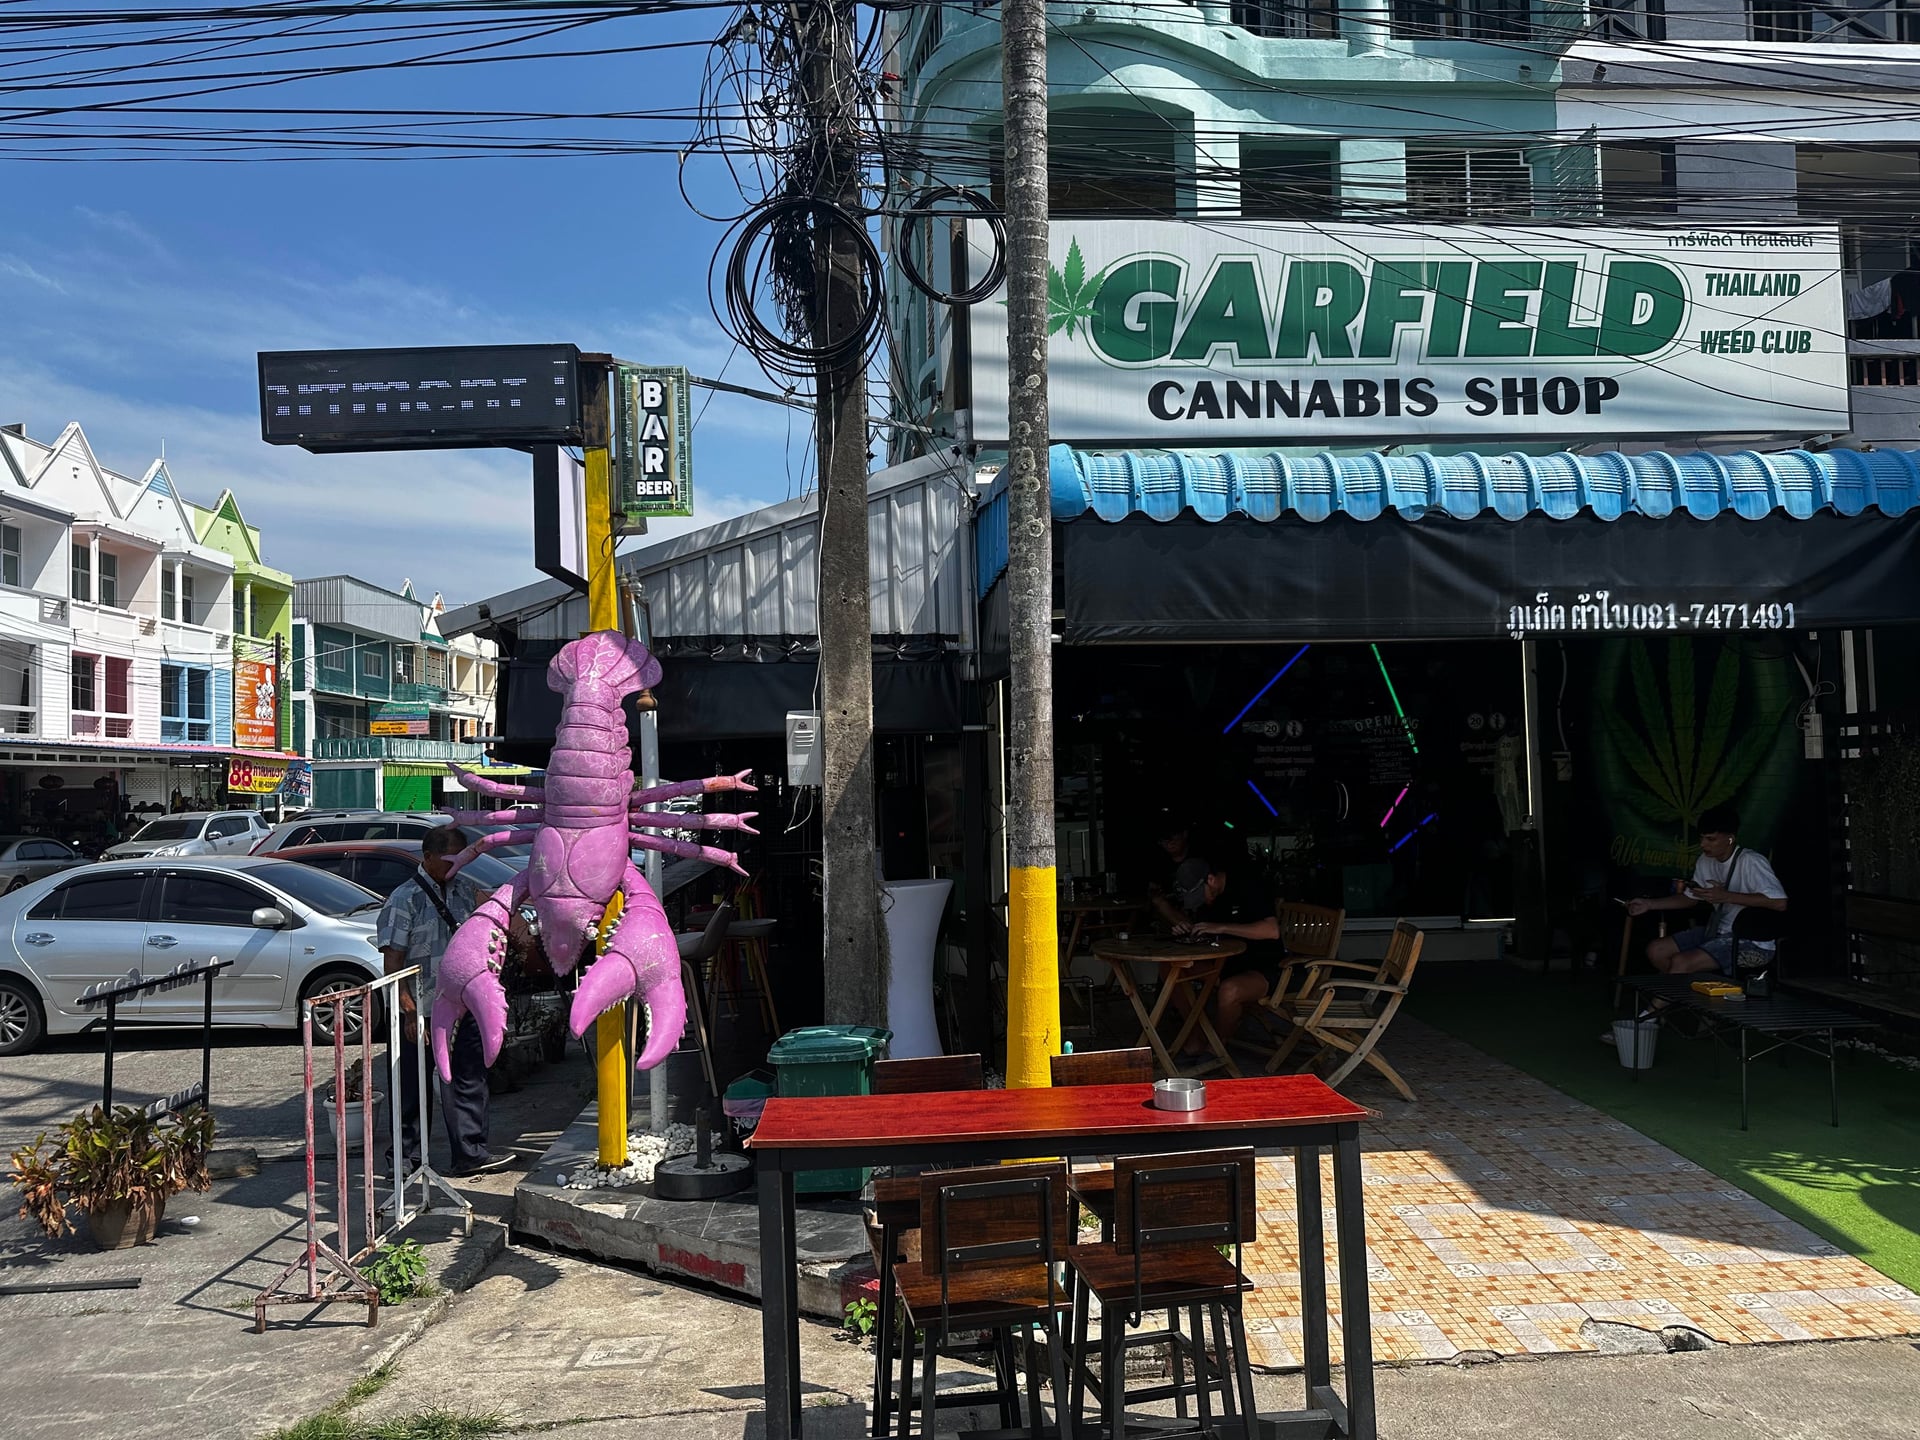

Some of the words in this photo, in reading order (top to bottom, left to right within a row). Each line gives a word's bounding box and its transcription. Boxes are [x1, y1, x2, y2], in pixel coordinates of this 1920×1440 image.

[1705, 273, 1801, 296] THAILAND
[1087, 257, 1690, 366] GARFIELD
[1700, 330, 1756, 354] WEED
[1761, 330, 1812, 354] CLUB
[1147, 377, 1439, 420] CANNABIS
[1464, 376, 1620, 415] SHOP
[641, 380, 666, 474] BAR
[636, 480, 673, 496] BEER
[229, 758, 253, 787] 88
